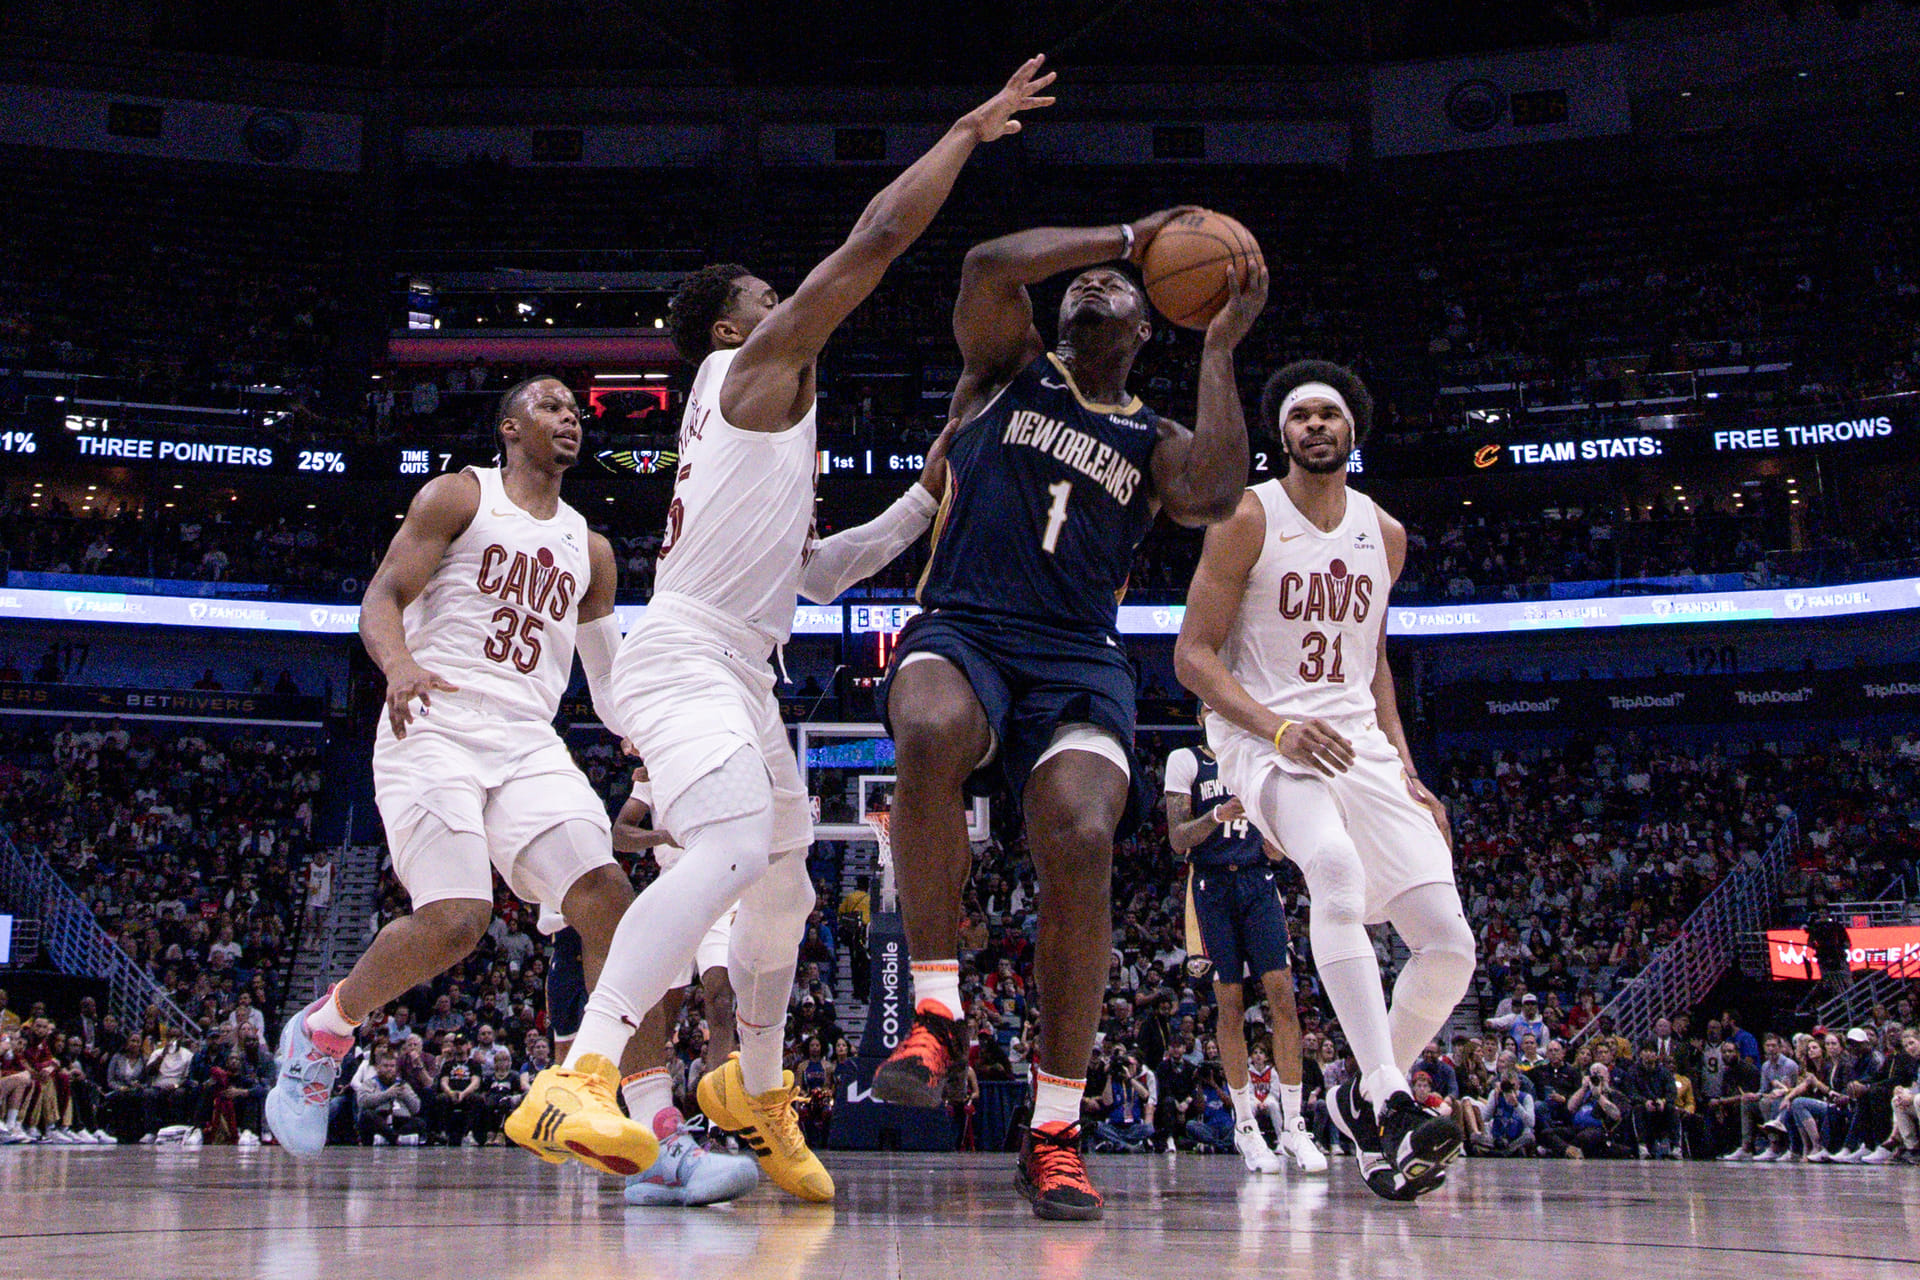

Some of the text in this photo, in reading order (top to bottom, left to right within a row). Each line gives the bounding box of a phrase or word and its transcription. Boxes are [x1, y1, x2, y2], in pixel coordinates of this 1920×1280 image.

[0, 431, 37, 453] 1%
[1714, 416, 1893, 450] FREE THROWS
[76, 436, 273, 466] THREE POINTERS
[401, 450, 429, 462] TIME
[1002, 410, 1142, 506] NEW ORLEANS
[1508, 436, 1663, 464] TEAM STATS:
[298, 451, 345, 473] 25%
[400, 462, 429, 474] OUTS
[439, 453, 452, 472] 7
[832, 456, 855, 468] 1st
[889, 454, 924, 470] 6:13
[1254, 452, 1269, 471] 2
[1042, 479, 1073, 554] 1
[476, 543, 576, 622] CAVS
[1278, 570, 1374, 624] CAVS
[1808, 592, 1870, 608] FANDUEL
[1419, 612, 1481, 626] FANDUEL
[483, 606, 545, 675] 35
[1299, 630, 1346, 684] 31
[126, 693, 257, 712] BETRIVERS
[883, 1002, 899, 1049] COX
